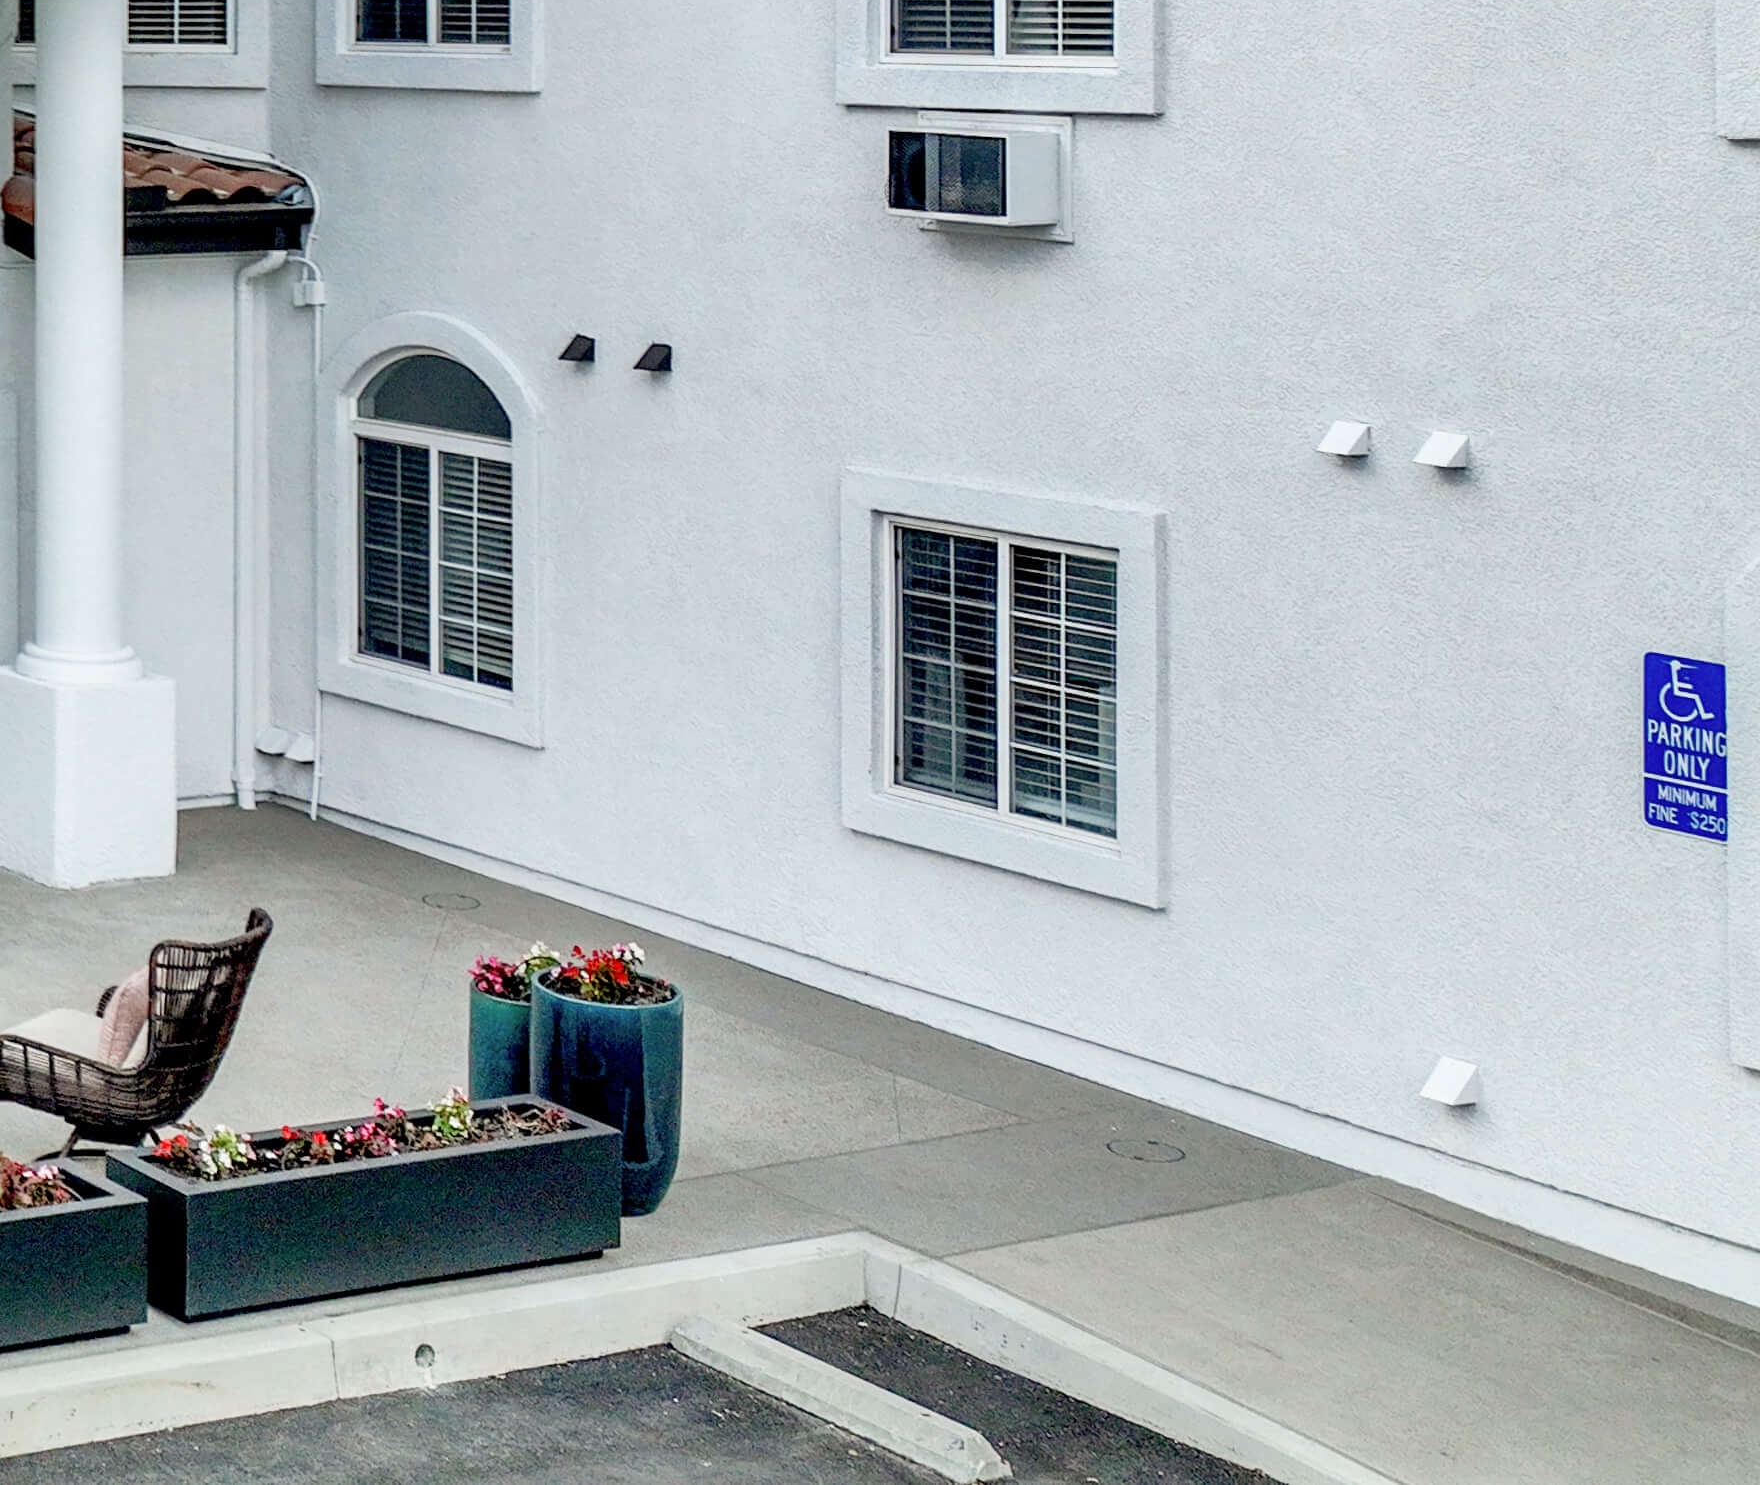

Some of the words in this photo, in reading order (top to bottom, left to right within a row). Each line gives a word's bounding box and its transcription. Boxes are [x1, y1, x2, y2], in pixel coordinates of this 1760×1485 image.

[1648, 719, 1727, 757] PARKING
[1664, 750, 1710, 781] ONLY
[1658, 784, 1717, 811] MINIMUM
[1648, 803, 1679, 825] FINE
